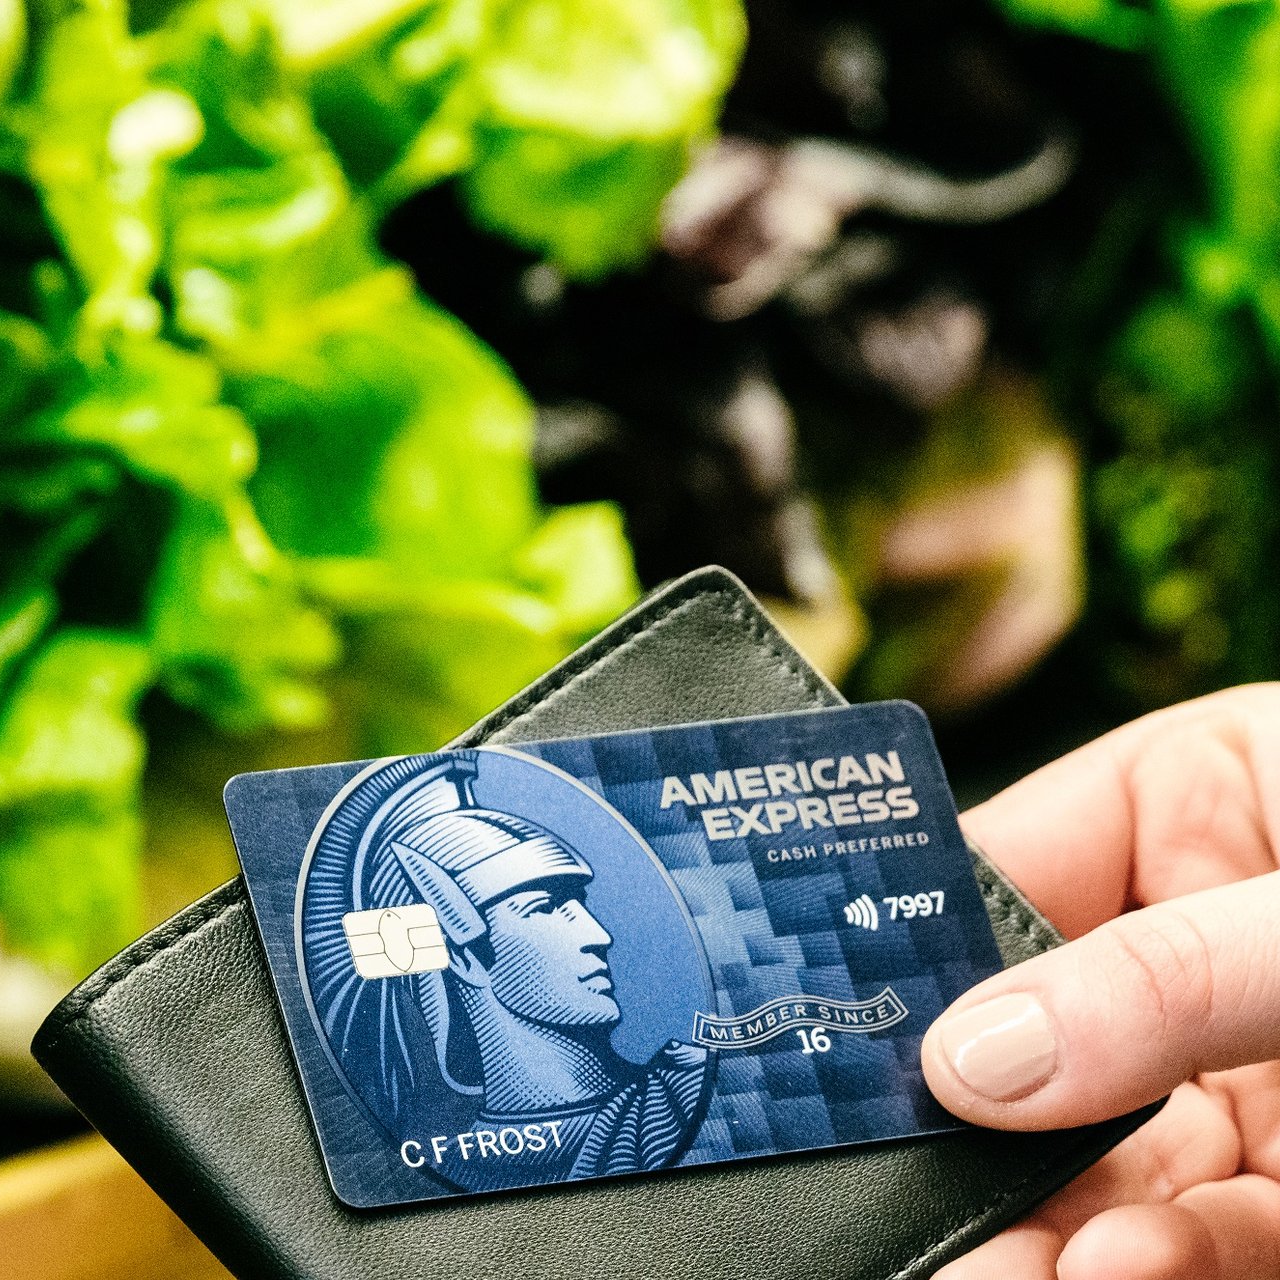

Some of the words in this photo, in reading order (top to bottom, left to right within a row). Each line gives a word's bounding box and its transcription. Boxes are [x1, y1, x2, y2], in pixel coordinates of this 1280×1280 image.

[660, 751, 905, 809] AMERICAN
[701, 786, 919, 841] EXPRESS
[767, 845, 817, 863] CASH
[823, 832, 930, 856] PREFERRED
[882, 890, 945, 920] 7997
[709, 1005, 806, 1041] MEMBER
[820, 1004, 889, 1023] SINCE
[796, 1027, 832, 1054] 16
[400, 1140, 425, 1168] C
[431, 1136, 448, 1164] F
[457, 1120, 562, 1160] FROST
